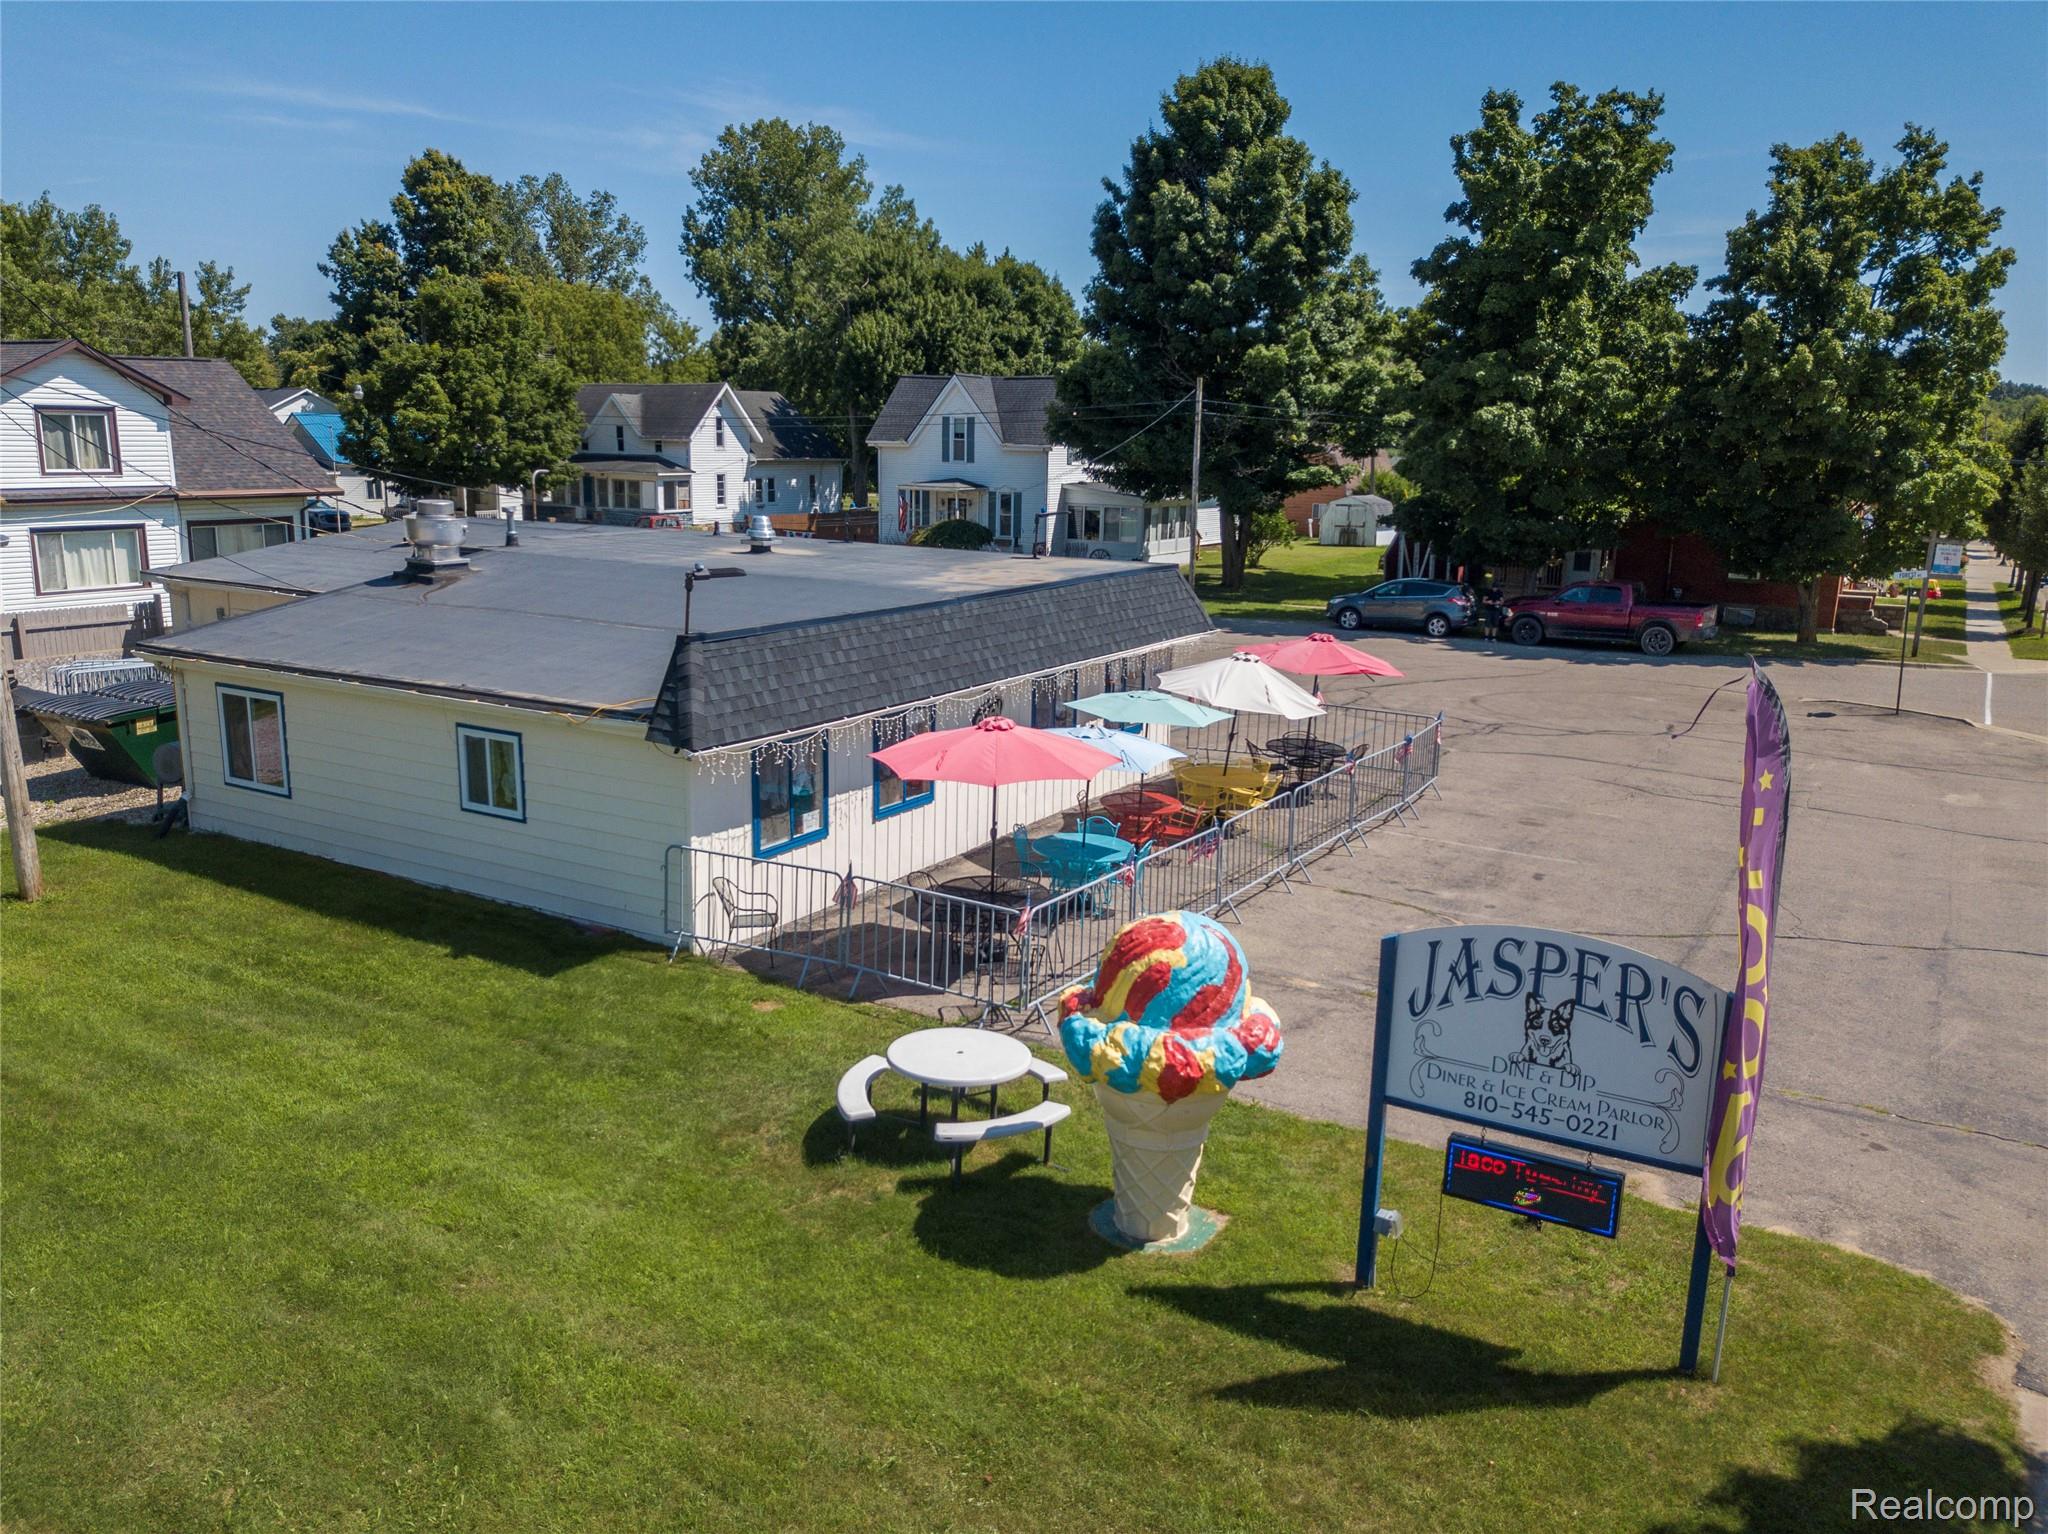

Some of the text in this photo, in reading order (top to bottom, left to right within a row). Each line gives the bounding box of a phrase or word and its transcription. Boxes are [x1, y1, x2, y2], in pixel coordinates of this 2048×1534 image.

[1407, 937, 1706, 1077] JASPER'S
[1427, 1062, 1664, 1130] DINER & ICE CREAM PARLOR
[1492, 1055, 1596, 1092] DINE & DIP
[1464, 1091, 1618, 1141] 810-545-0221
